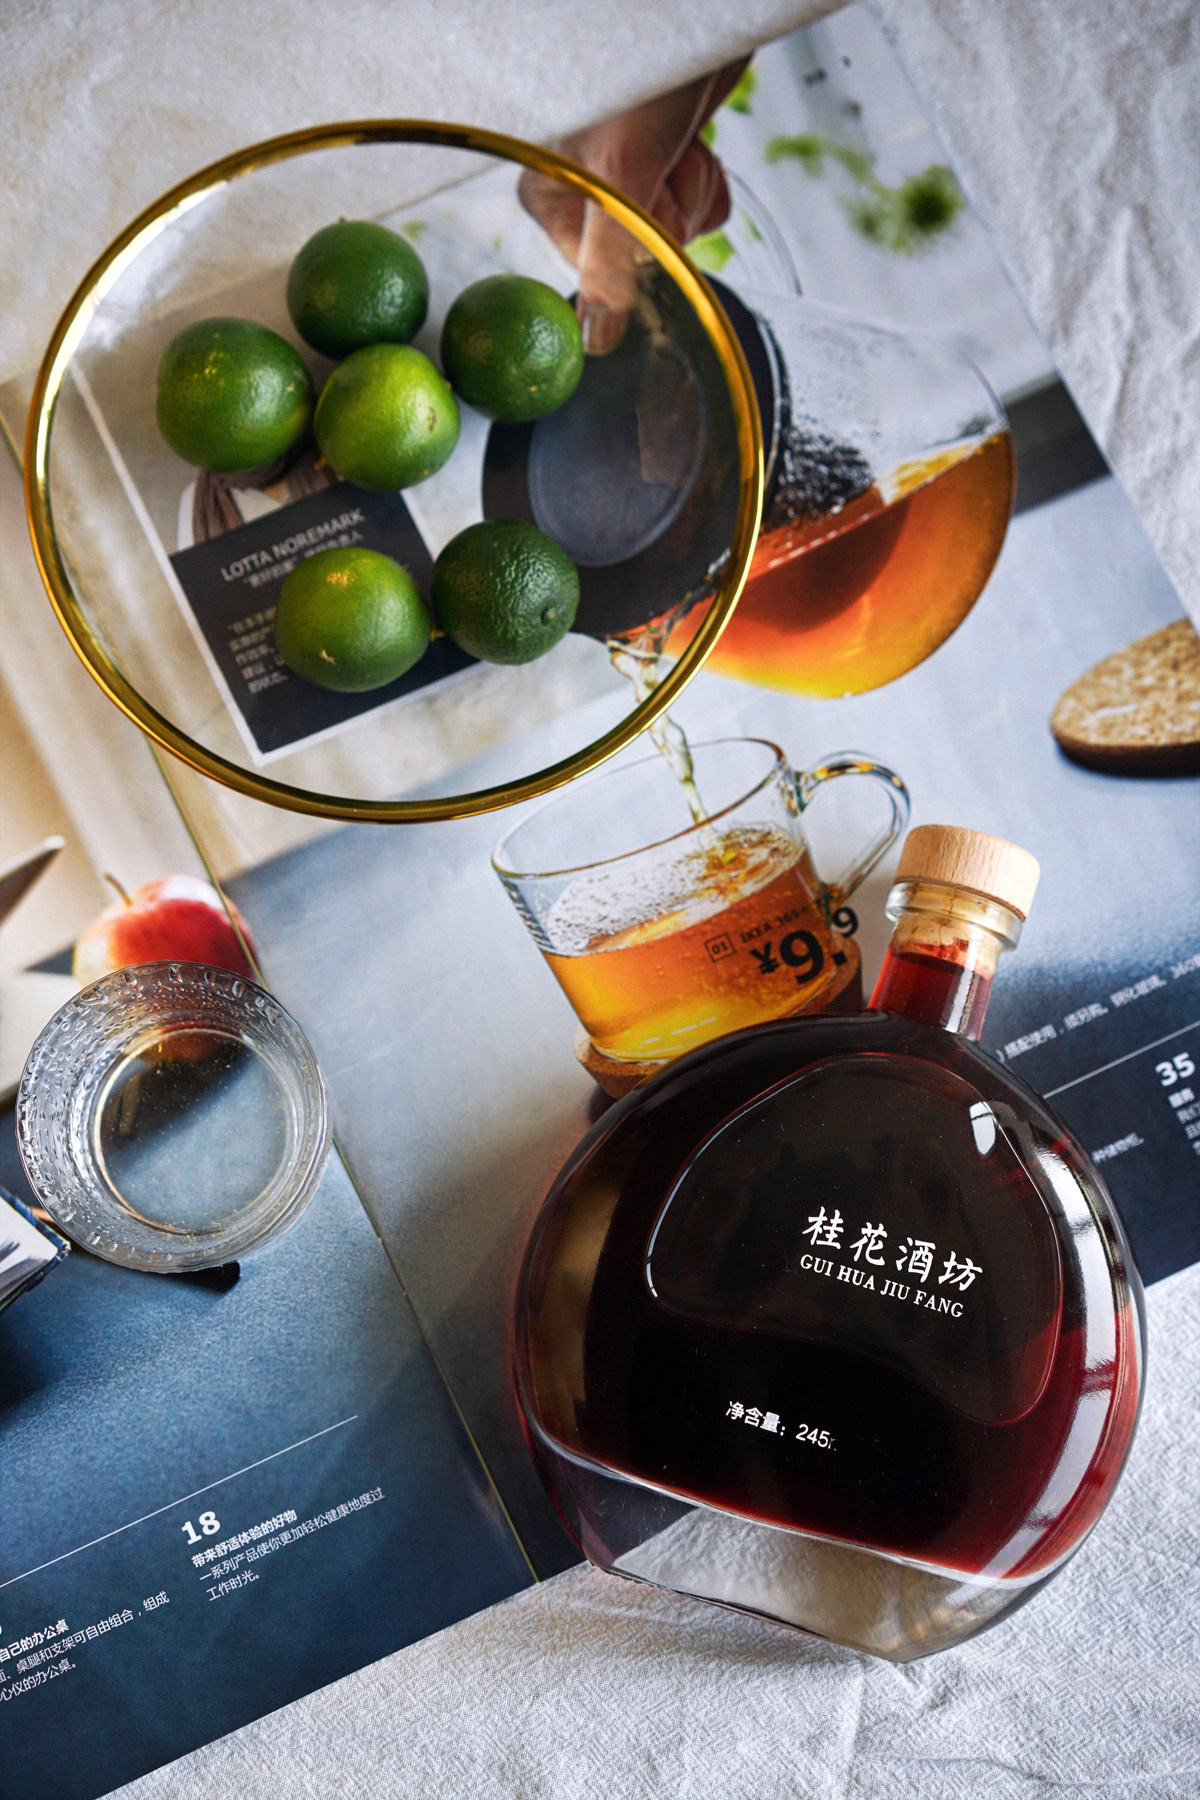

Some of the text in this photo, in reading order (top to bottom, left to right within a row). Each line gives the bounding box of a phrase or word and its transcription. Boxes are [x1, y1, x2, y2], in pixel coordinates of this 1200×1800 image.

[220, 544, 272, 582] LOTTA
[271, 507, 366, 558] NOREMARK
[711, 941, 728, 955] 01
[740, 922, 773, 944] IKEA
[1155, 1051, 1196, 1087] 35
[802, 1206, 984, 1292] 桂花酒坊
[800, 1253, 965, 1318] GUI HUA JIU FANG
[181, 1510, 221, 1546] 18
[191, 1508, 298, 1569] 带来舒适体验的好物
[199, 1485, 386, 1581] 一系列产品使你更加轻松健康地度过
[205, 1569, 260, 1602] 工作时光。
[0, 1618, 70, 1664] 自己的办公桌
